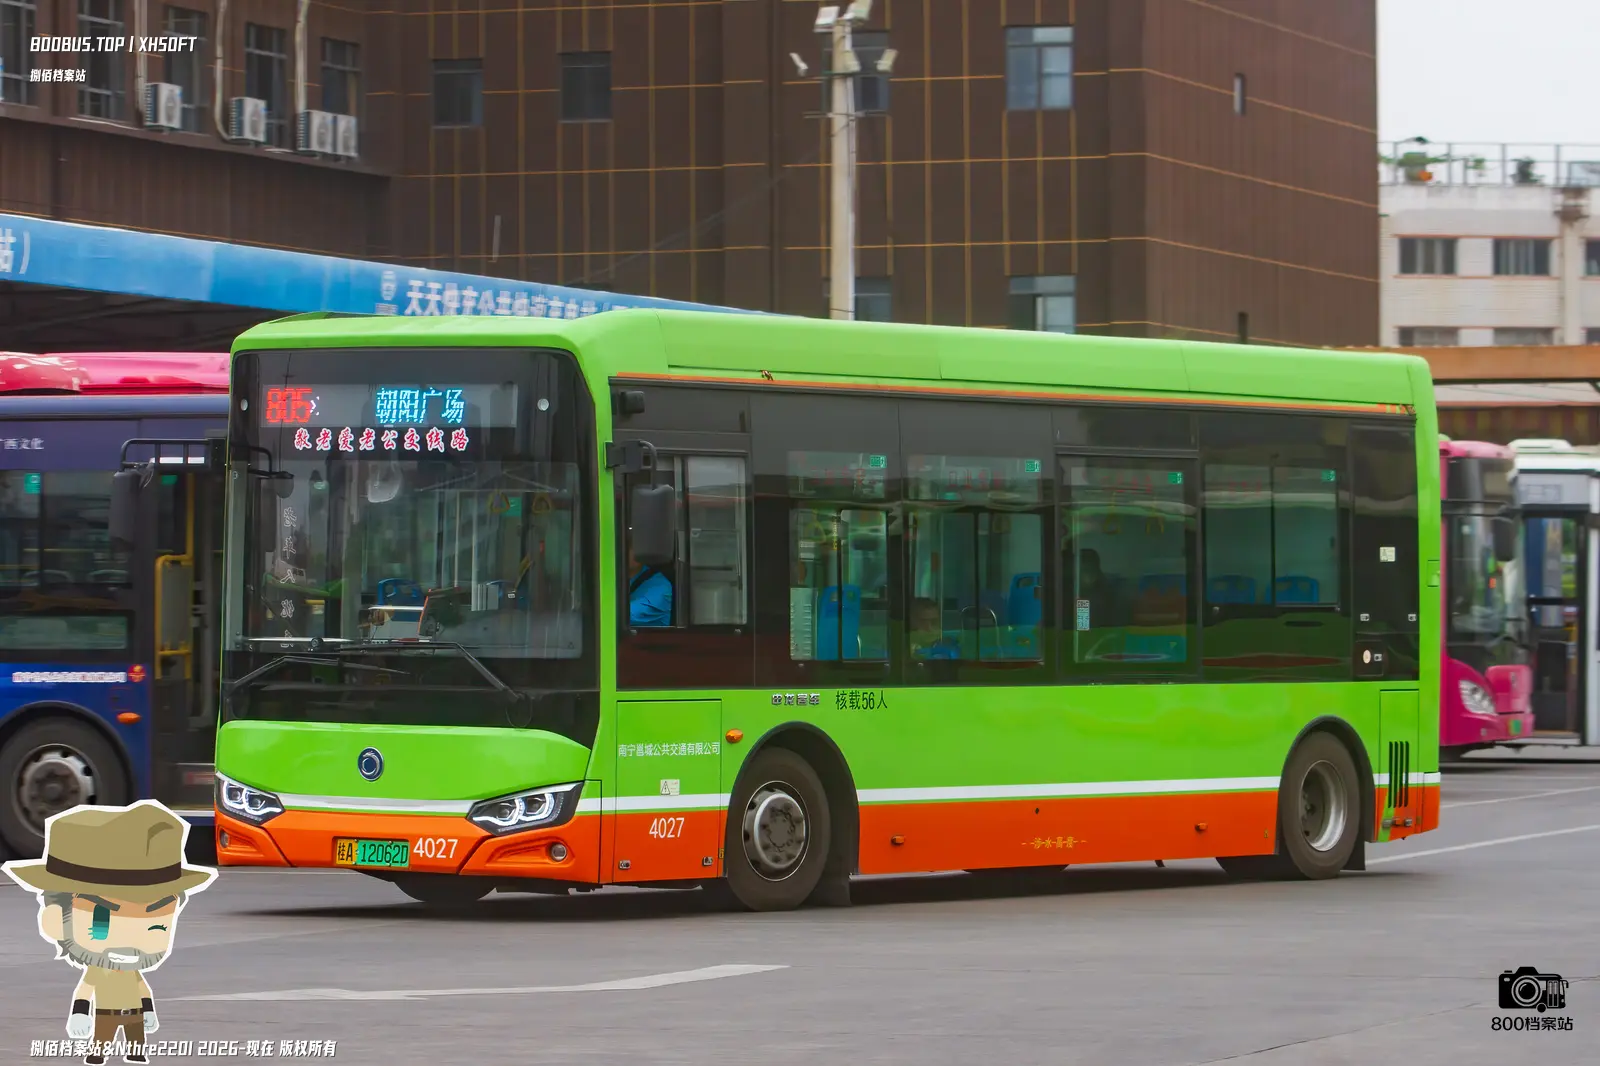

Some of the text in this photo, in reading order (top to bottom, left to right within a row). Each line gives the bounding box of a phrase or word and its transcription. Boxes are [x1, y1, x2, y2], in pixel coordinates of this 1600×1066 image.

[376, 387, 466, 424] 朝阳广场
[293, 427, 469, 453] 敬老爱老公交线路
[836, 690, 888, 710] 核载56人
[618, 741, 721, 757] 南宁邕城公共交通有限公司
[648, 816, 685, 839] 4027
[337, 842, 409, 865] 桂A 12062D
[412, 836, 459, 859] 4027
